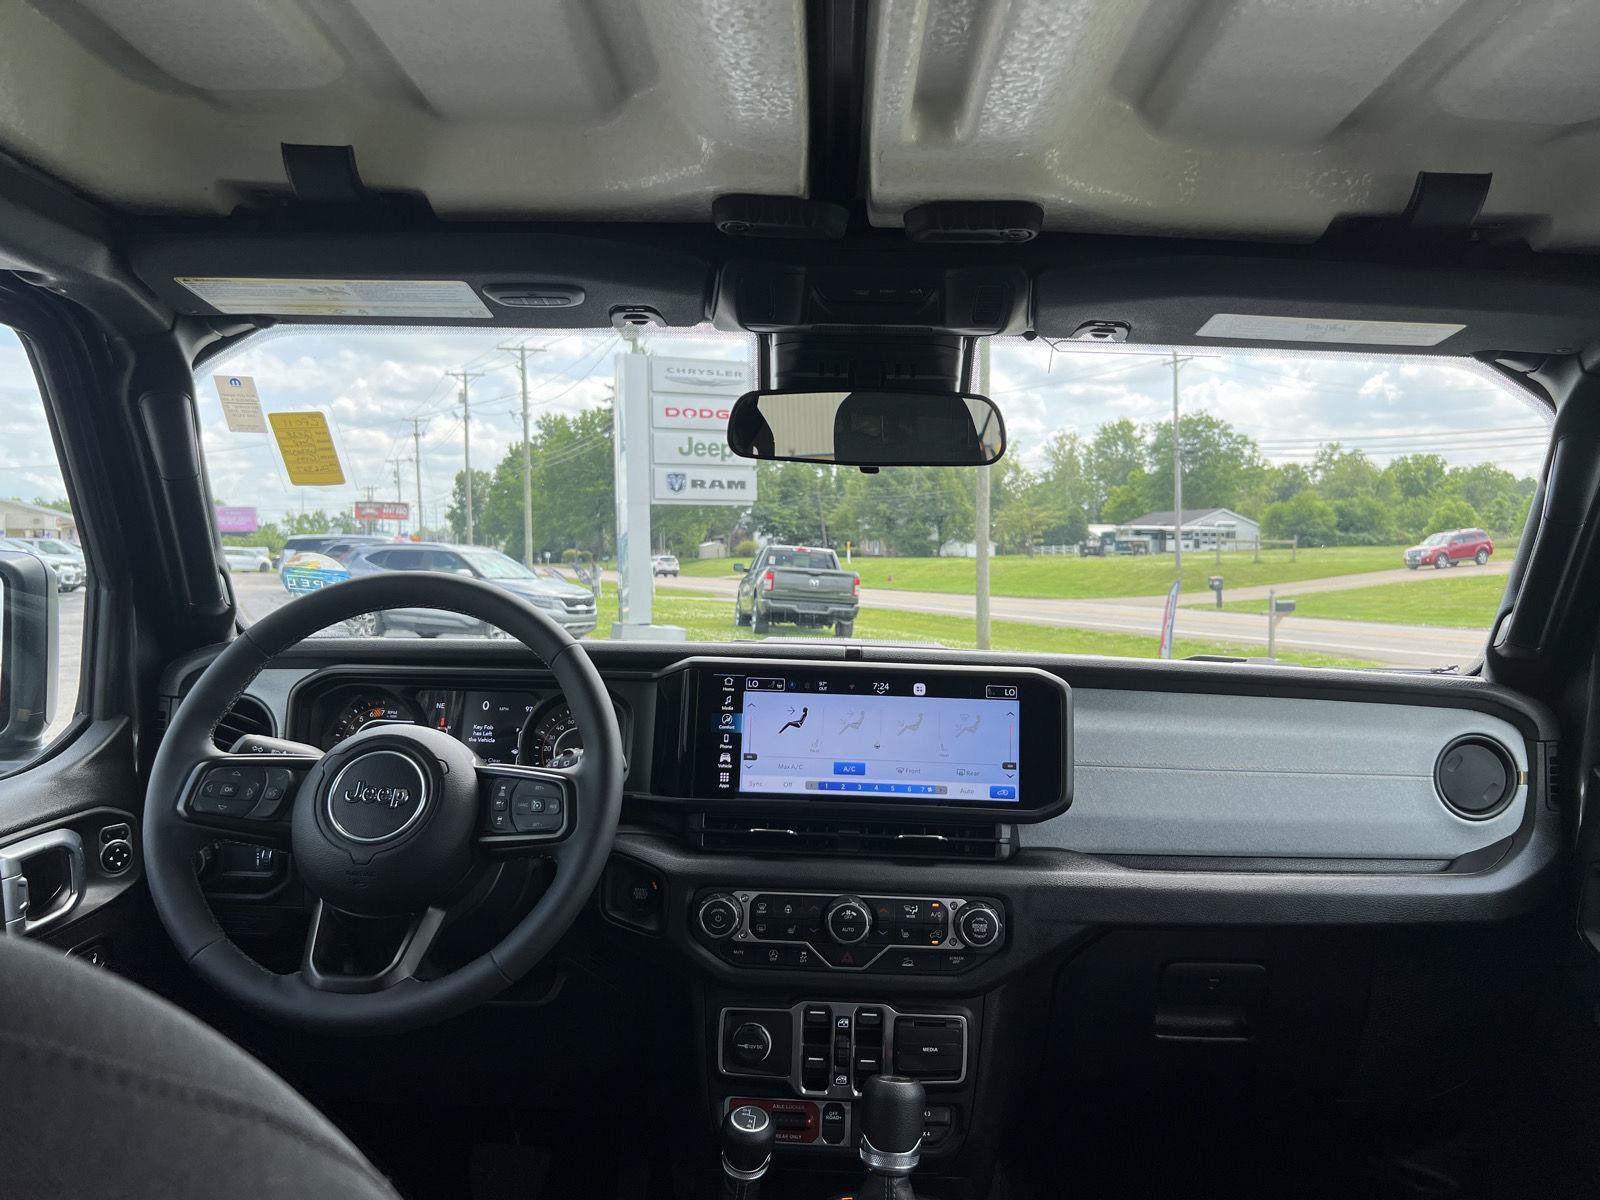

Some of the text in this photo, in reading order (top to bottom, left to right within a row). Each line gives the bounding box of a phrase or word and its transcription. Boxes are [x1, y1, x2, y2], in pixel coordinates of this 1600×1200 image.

[666, 367, 743, 378] CHRYSLER
[665, 407, 730, 420] DODG
[678, 436, 733, 462] Jeep
[691, 479, 747, 490] RAM
[748, 680, 759, 688] LO
[872, 682, 889, 691] 7:24
[1004, 688, 1016, 696] LO
[483, 701, 489, 711] 0
[842, 764, 856, 773] A/C
[345, 781, 409, 807] Jeep
